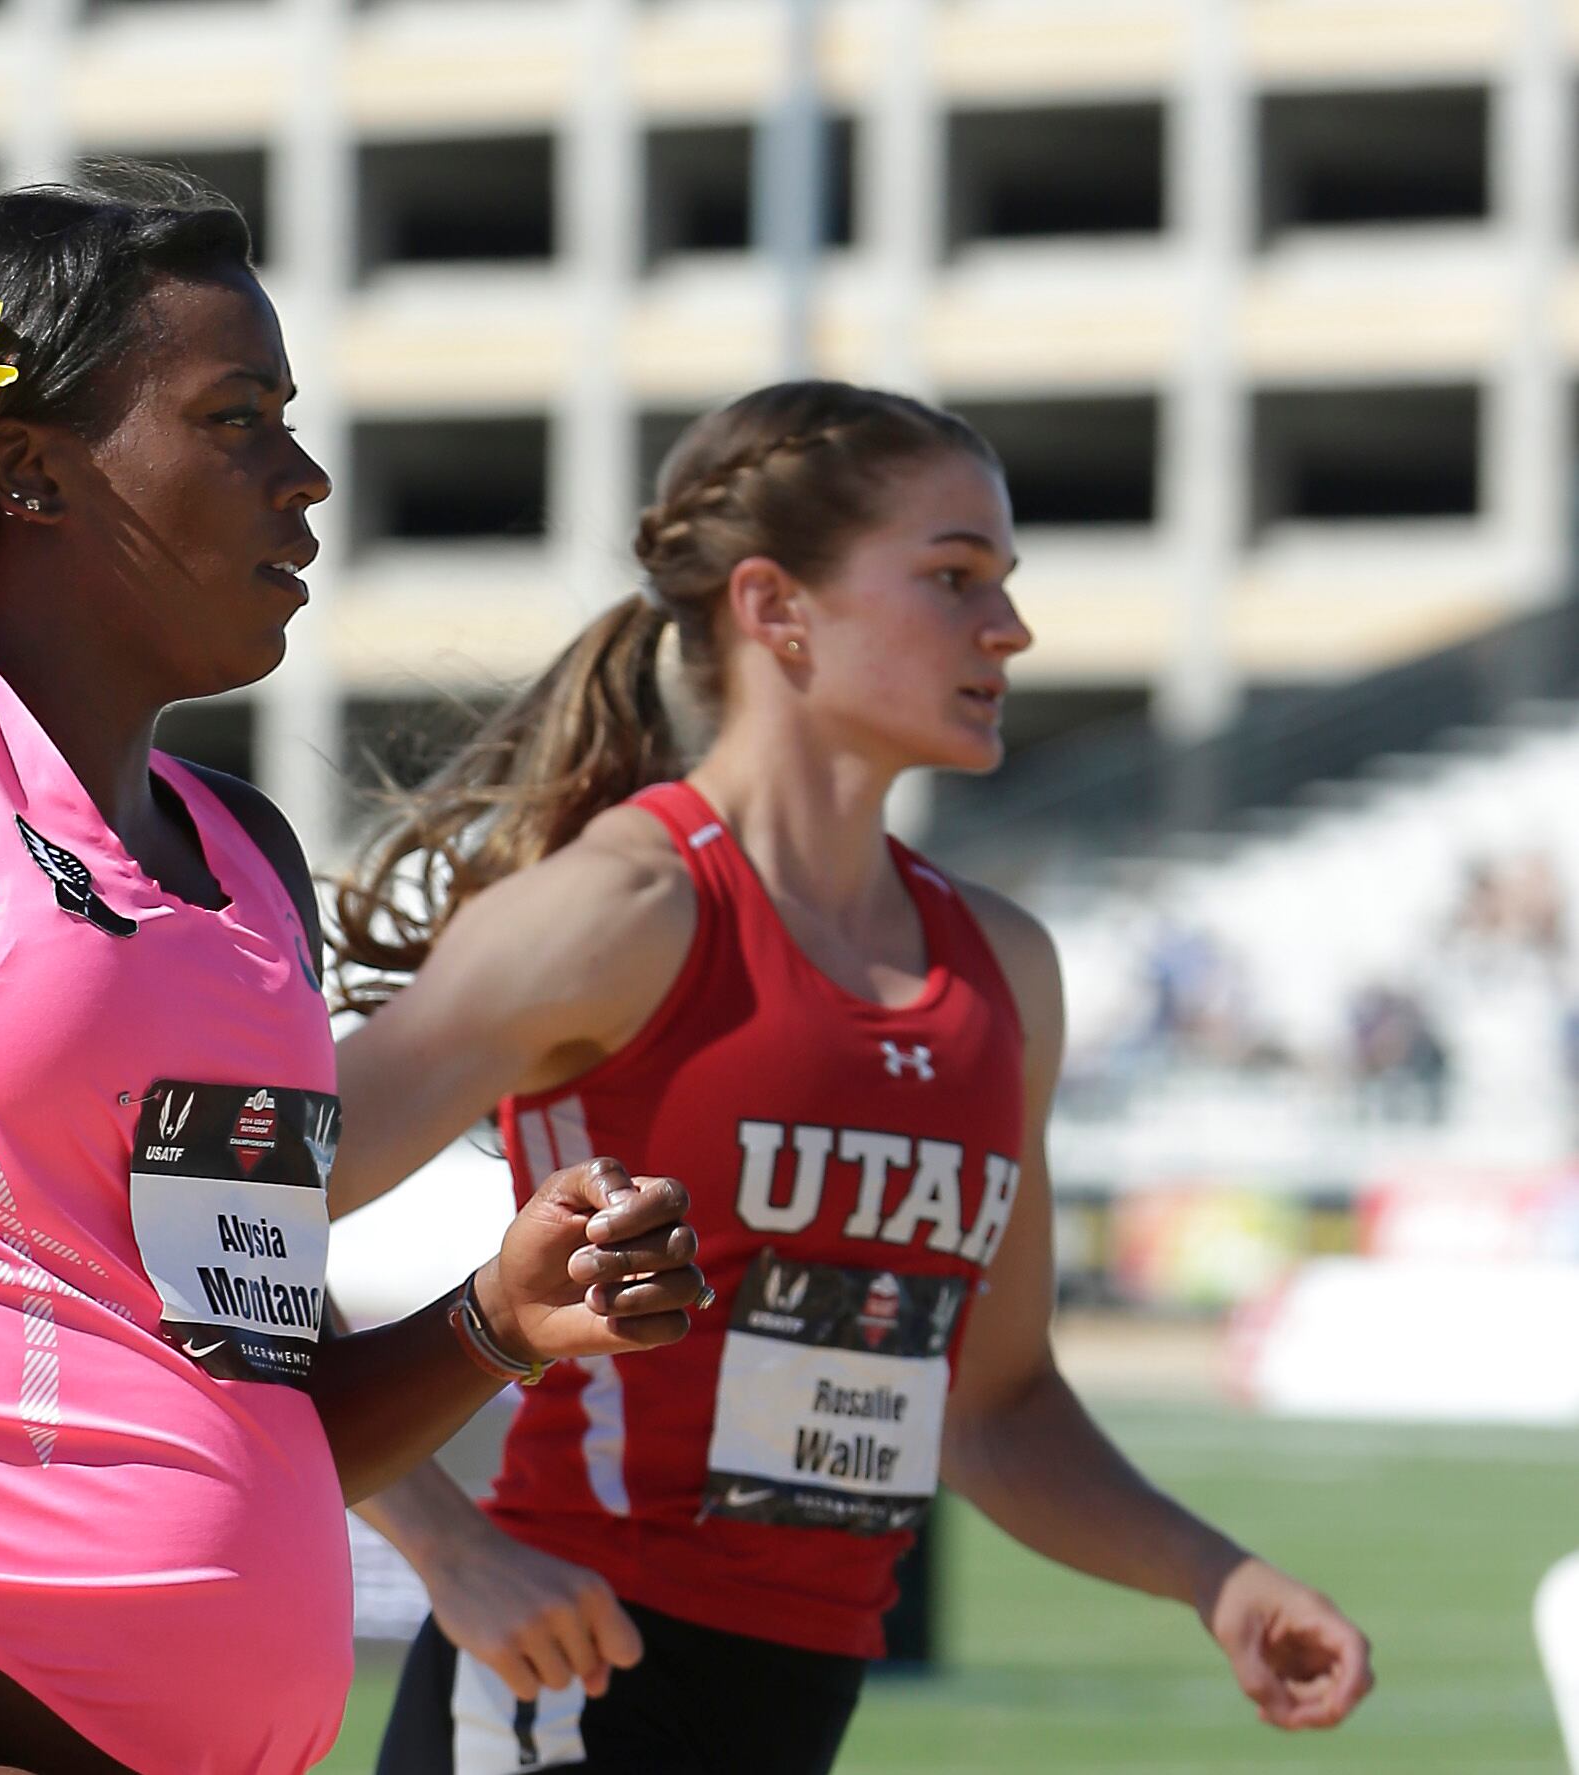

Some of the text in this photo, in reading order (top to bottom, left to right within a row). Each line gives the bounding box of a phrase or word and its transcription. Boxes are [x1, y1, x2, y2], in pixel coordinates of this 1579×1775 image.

[145, 1145, 185, 1162] USATF
[736, 1119, 1021, 1266] UTAH
[217, 1214, 287, 1259] Alysia
[813, 1379, 908, 1422] Rosalie
[793, 1428, 899, 1482] Waller
